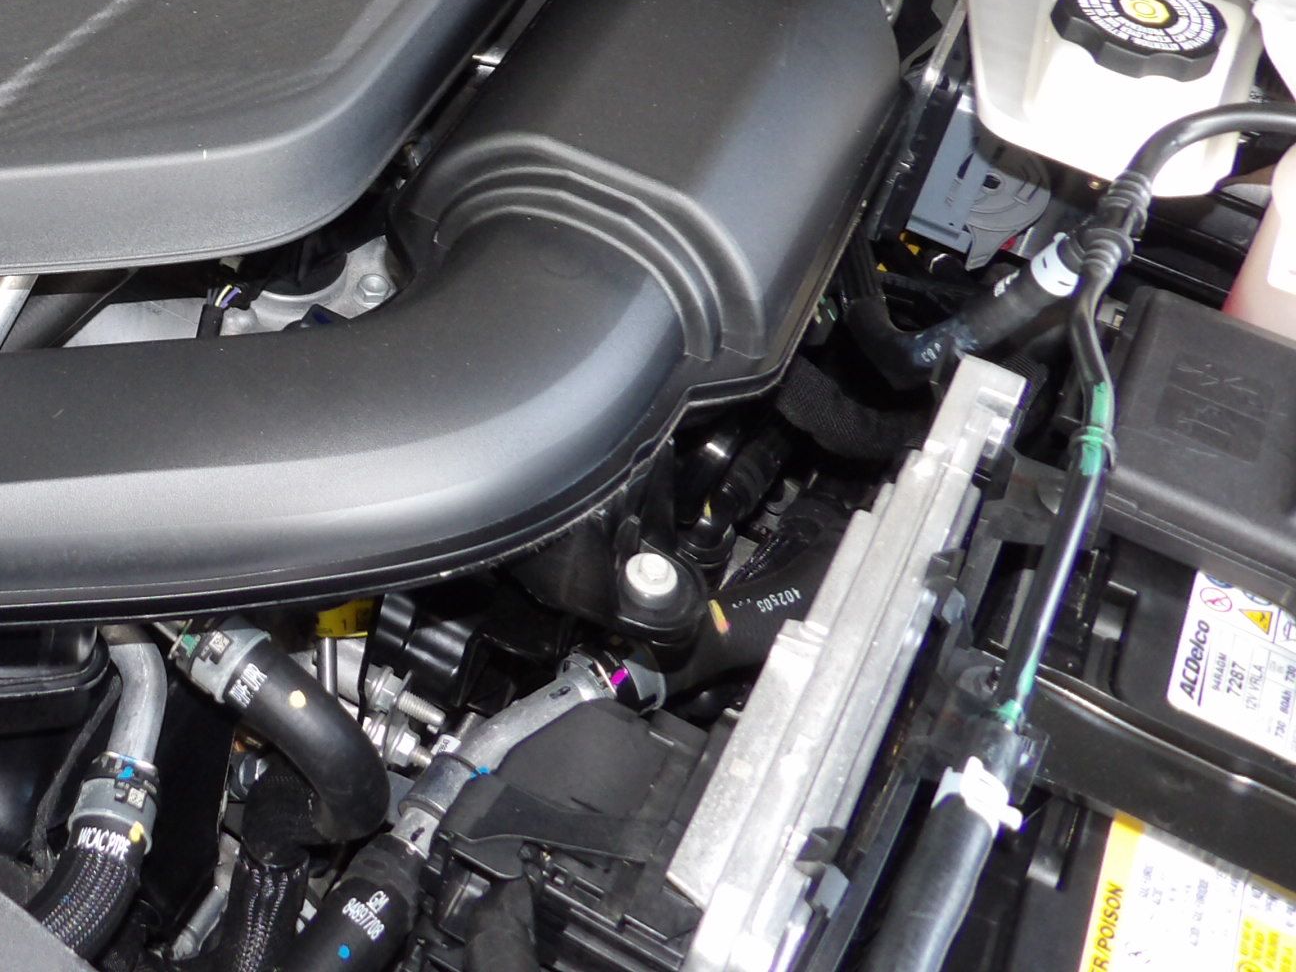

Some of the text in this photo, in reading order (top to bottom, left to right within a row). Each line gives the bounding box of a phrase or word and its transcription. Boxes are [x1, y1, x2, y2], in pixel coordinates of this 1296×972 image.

[1179, 620, 1210, 700] ACDelco
[1226, 660, 1246, 697] 7287
[1249, 664, 1265, 696] VRLA
[1091, 882, 1124, 972] R/POISON
